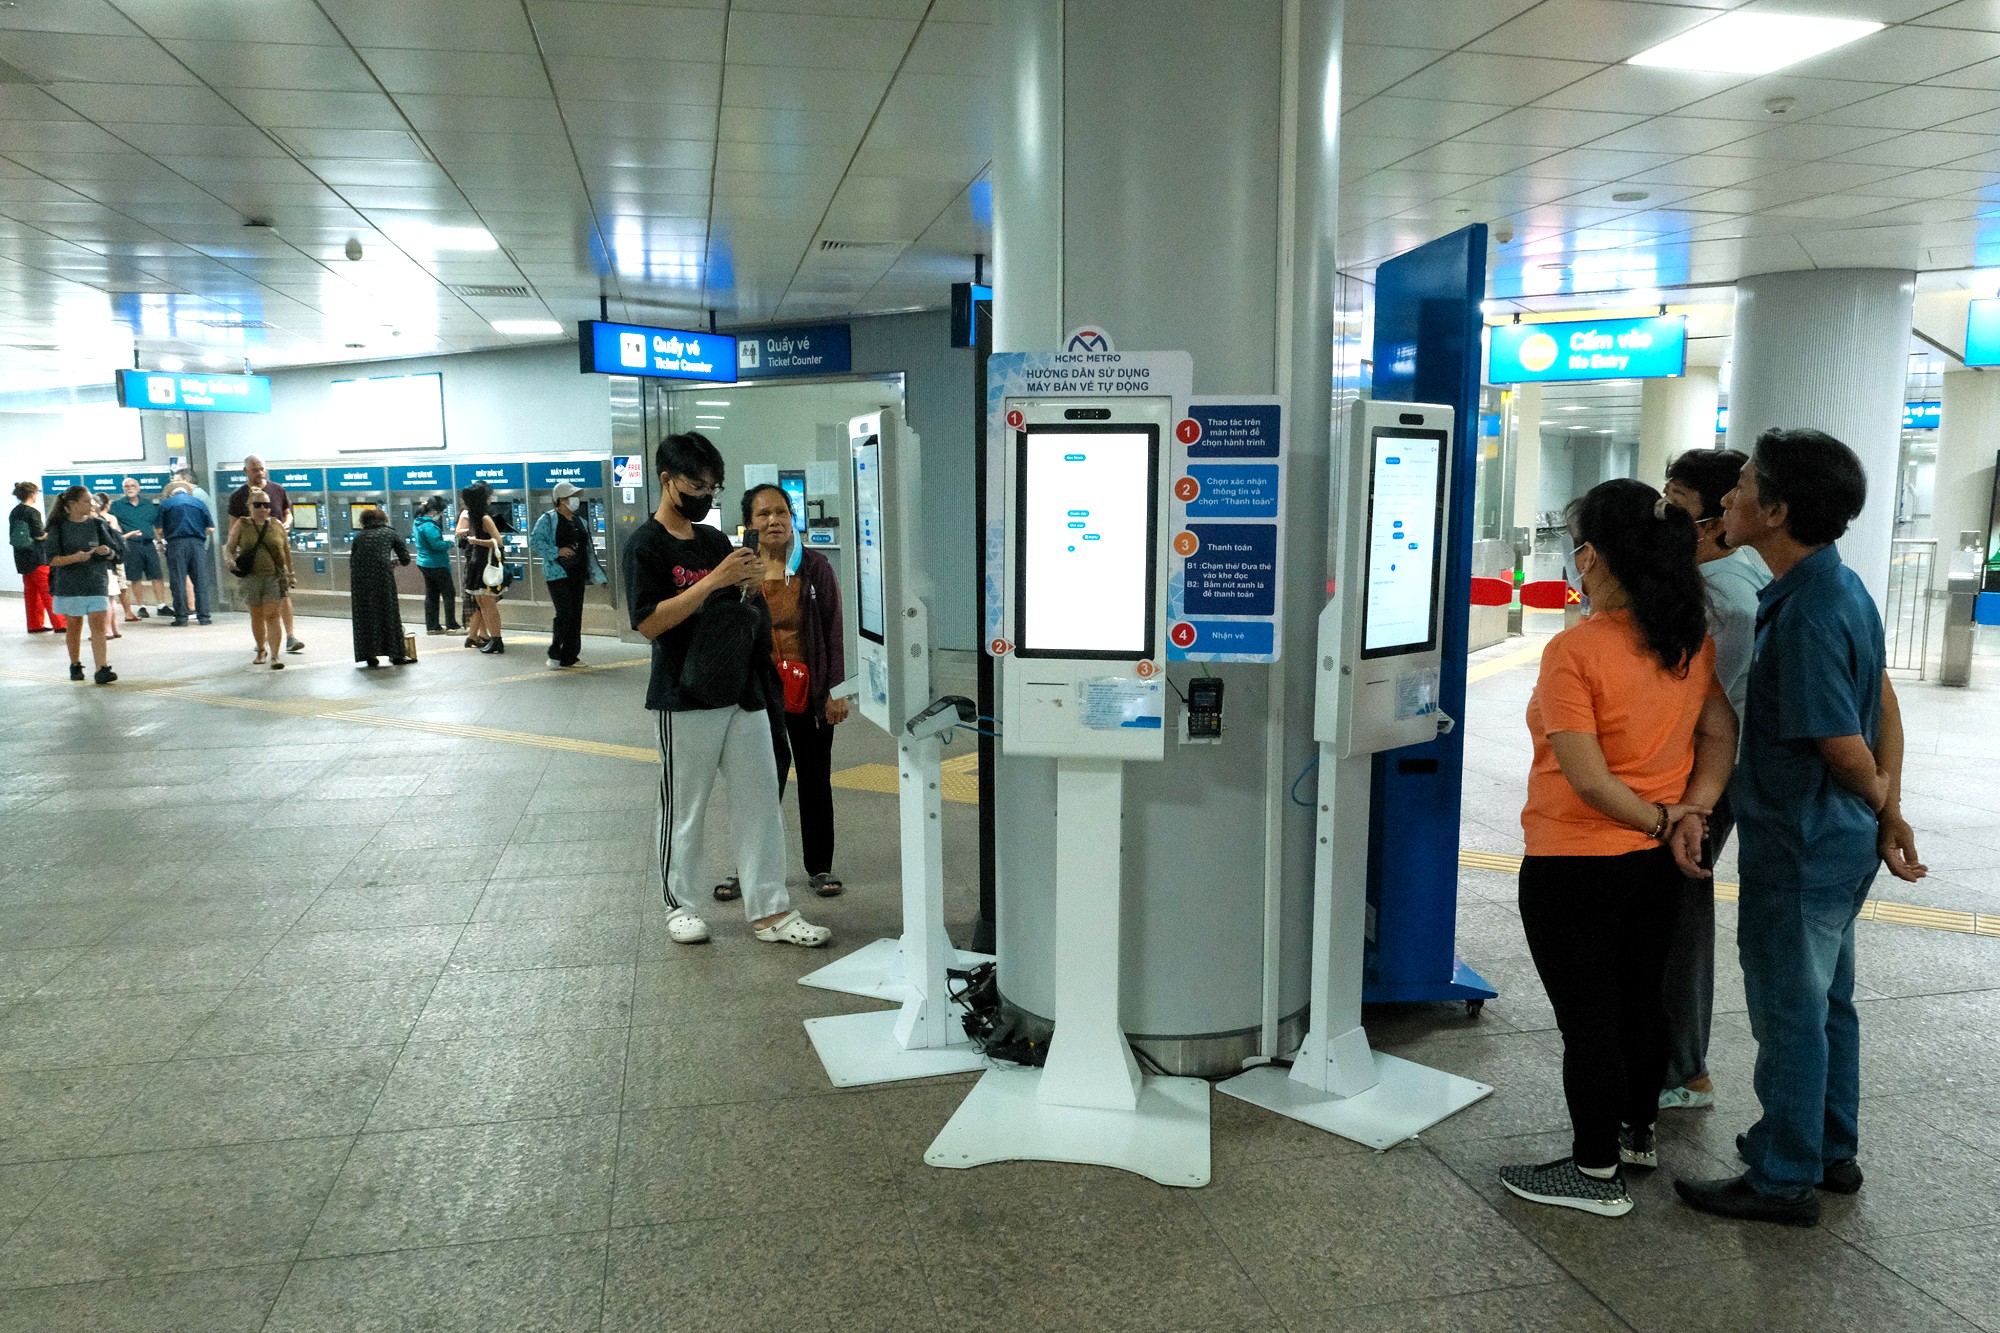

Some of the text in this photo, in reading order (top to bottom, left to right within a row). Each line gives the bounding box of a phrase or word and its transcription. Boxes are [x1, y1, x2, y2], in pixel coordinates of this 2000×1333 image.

[767, 336, 810, 354] Quầy vé
[768, 354, 823, 367] Ticket Counter
[1055, 354, 1121, 363] HCMC METRO
[1569, 354, 1629, 370] No Entry
[654, 356, 713, 373] Ticket Counter
[1026, 366, 1150, 380] HƯỚNG DẪN SỬ DỤNG
[1027, 380, 1149, 393] MÁY BÁN VÉ TỰ ĐỘNG
[1011, 413, 1017, 424] 1
[1207, 418, 1261, 426] Thao tác trên
[1184, 426, 1191, 438] 1
[1249, 427, 1260, 436] để
[1201, 439, 1222, 448] chọn
[1206, 477, 1267, 486] Chọn xác nhận
[1182, 484, 1191, 496] 2
[1212, 488, 1236, 497] thông
[1198, 498, 1219, 507] chọn
[1181, 539, 1189, 551] 3
[1207, 543, 1253, 551] Thanh toán
[1241, 562, 1258, 570] Đưa
[1259, 562, 1272, 570] thẻ
[1203, 571, 1249, 580] vào khe đọc
[1203, 580, 1221, 588] Bấm
[1222, 581, 1235, 589] nút
[1236, 581, 1255, 589] xanh
[1257, 581, 1264, 589] lá
[1202, 589, 1254, 598] để thanh toán
[1179, 629, 1187, 640] 4
[1212, 631, 1245, 640] Nhận vé
[995, 641, 1003, 652] 2
[1141, 664, 1149, 675] 3
